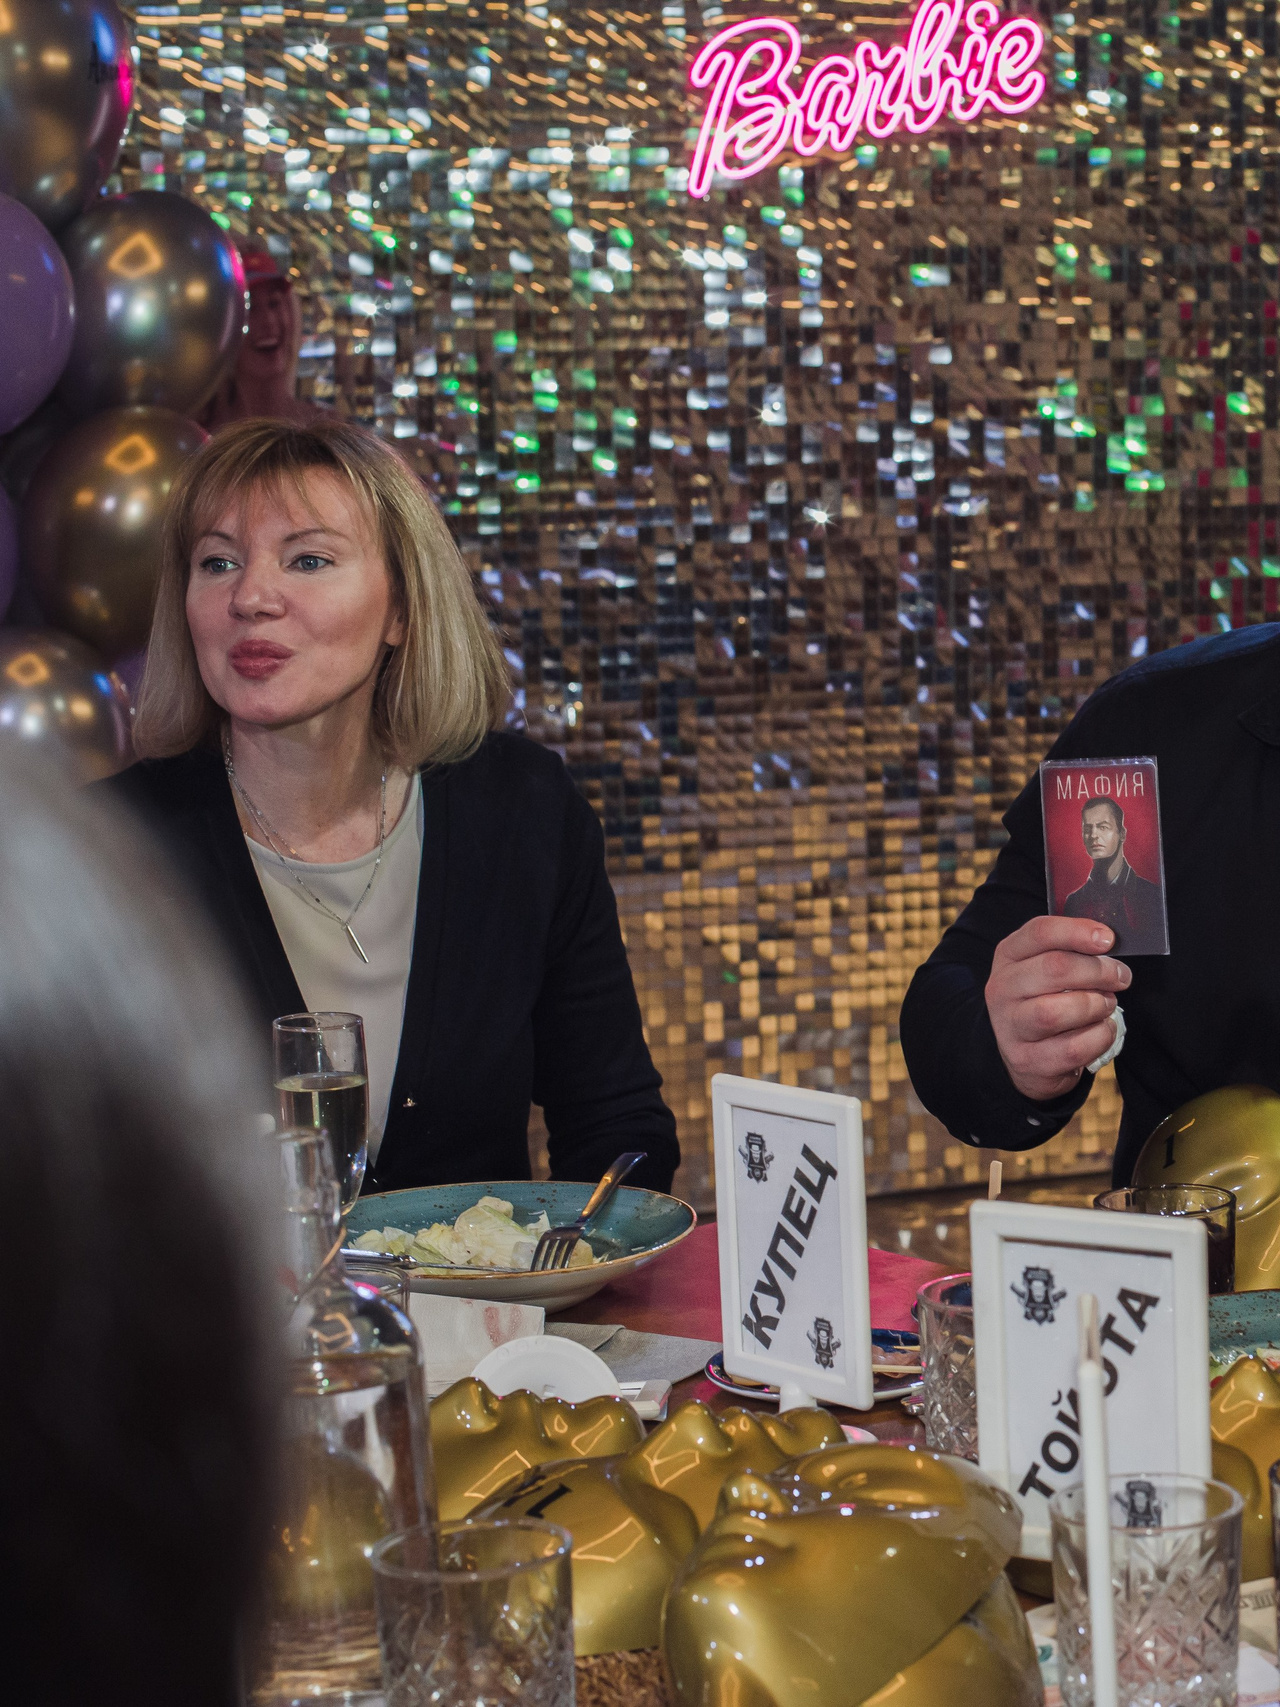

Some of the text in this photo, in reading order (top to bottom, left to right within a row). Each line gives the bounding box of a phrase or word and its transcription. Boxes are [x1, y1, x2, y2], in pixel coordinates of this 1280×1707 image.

[689, 0, 1045, 198] Barbie
[1056, 771, 1145, 800] МАФИЯ
[742, 1143, 838, 1351] КУПЕЦ
